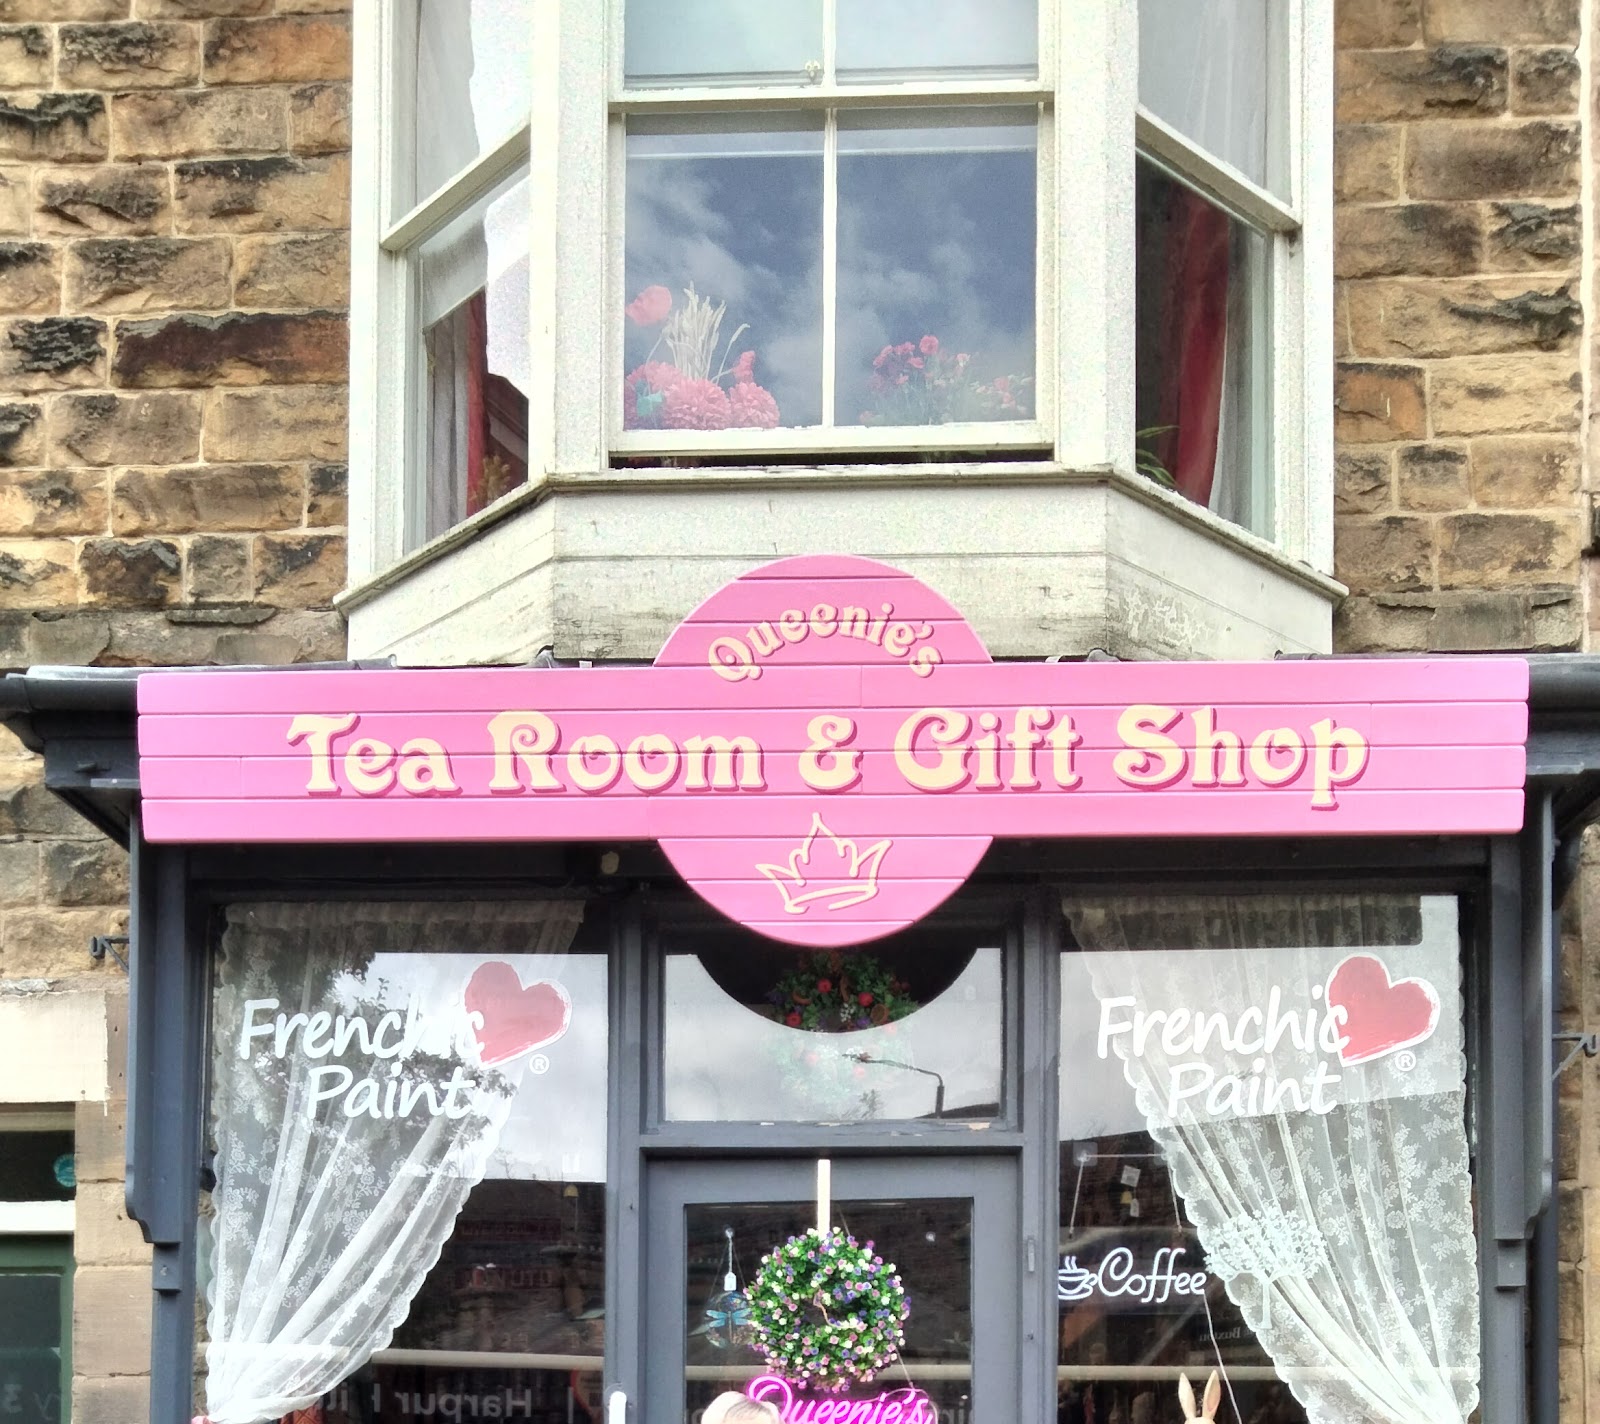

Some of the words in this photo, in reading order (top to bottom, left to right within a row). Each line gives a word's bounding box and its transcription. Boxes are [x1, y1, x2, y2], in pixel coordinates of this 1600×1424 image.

[708, 601, 943, 682] Queenie's
[287, 712, 461, 796] Tea
[485, 710, 768, 796] Room
[797, 714, 863, 794] &
[894, 705, 1083, 793] Gift
[1112, 703, 1370, 812] Shop
[239, 992, 485, 1061] Frenchic
[1097, 985, 1351, 1059] Frenchic
[306, 1060, 478, 1120] Paint
[1167, 1060, 1343, 1118] Paint
[1098, 1246, 1208, 1304] Coffee
